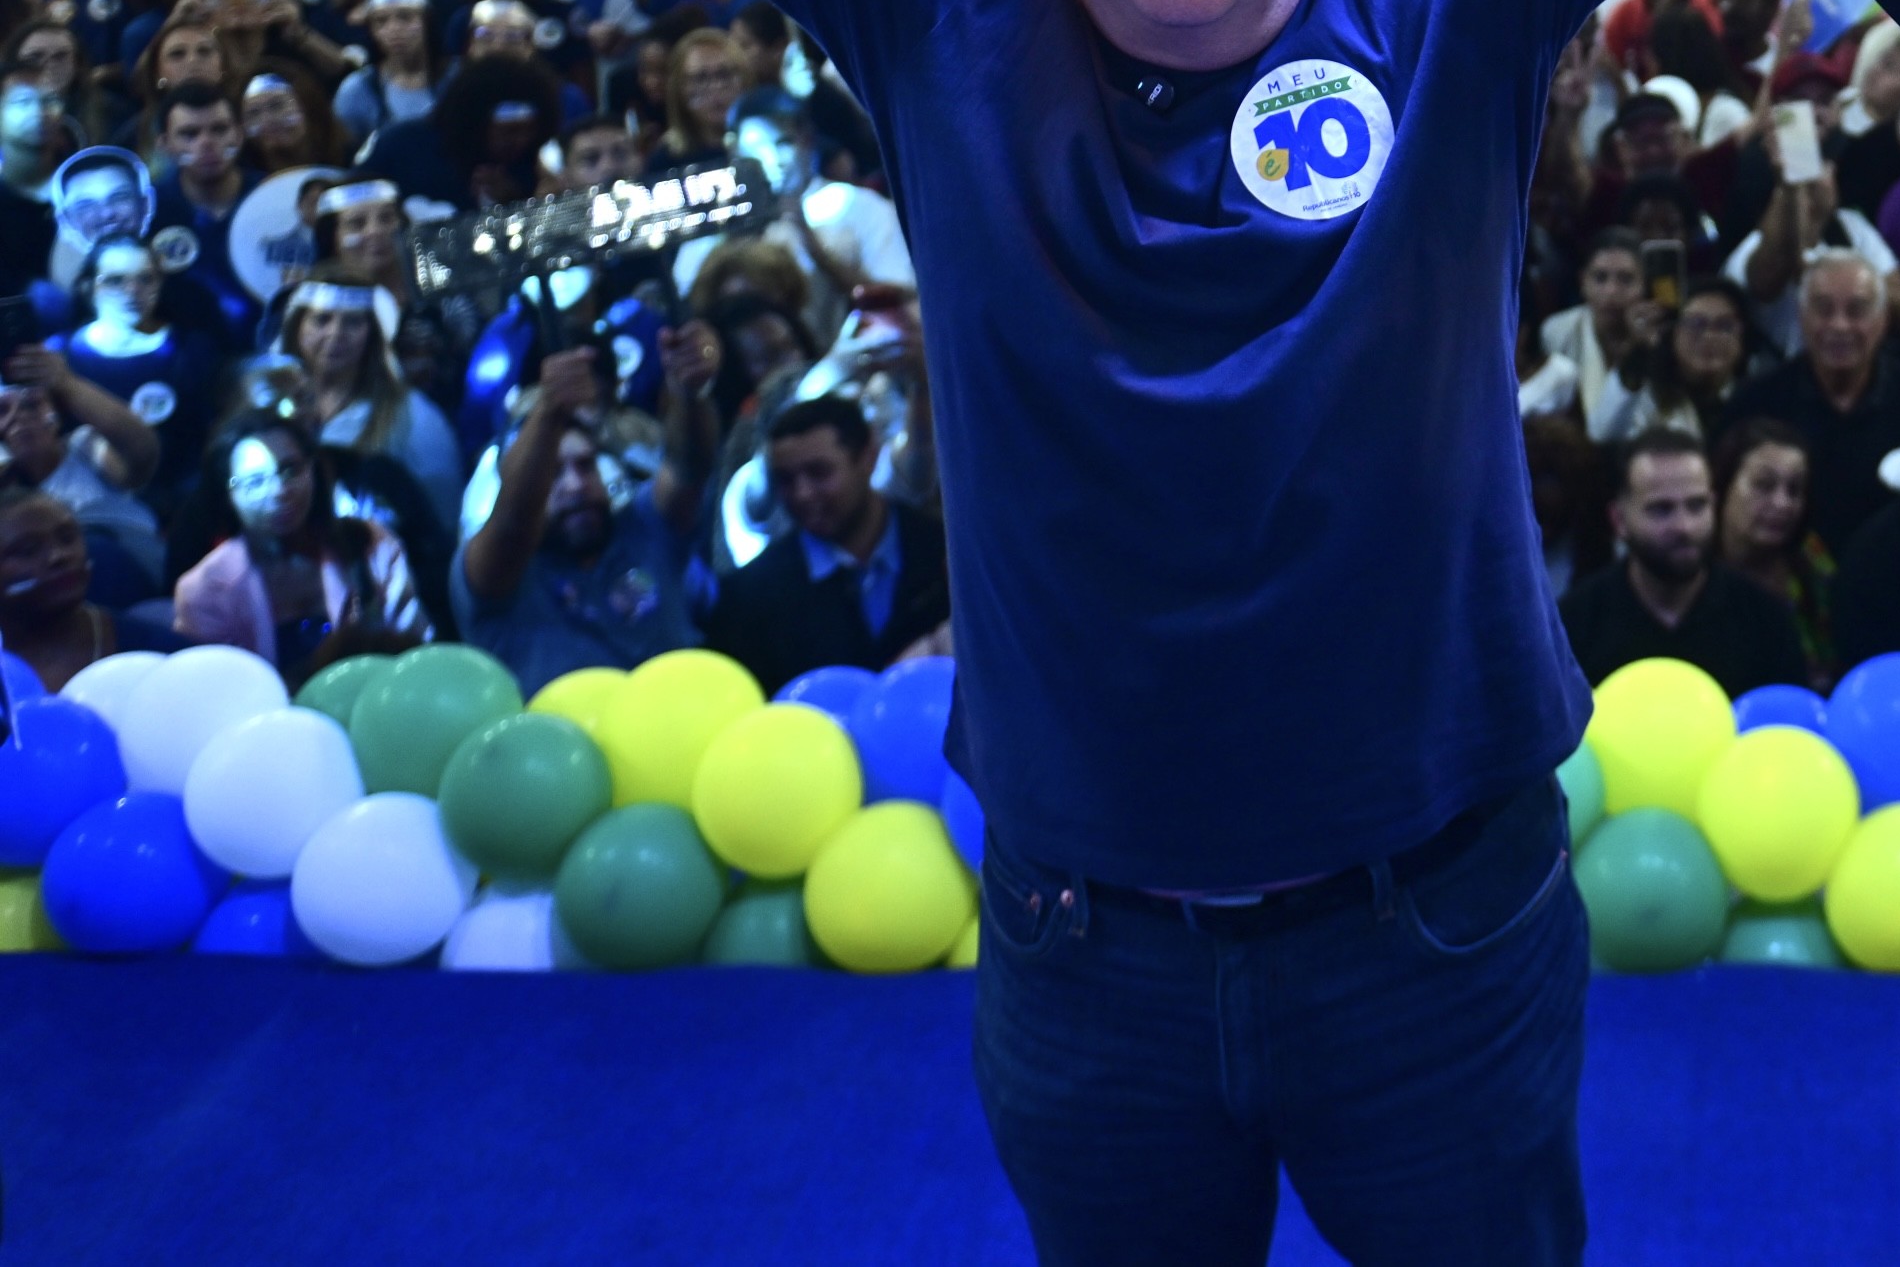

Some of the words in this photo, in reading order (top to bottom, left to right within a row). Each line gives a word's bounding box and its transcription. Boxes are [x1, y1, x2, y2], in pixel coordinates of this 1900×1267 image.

[1262, 81, 1343, 112] PARTIDO
[1267, 67, 1327, 95] MEU
[1253, 96, 1371, 192] 10
